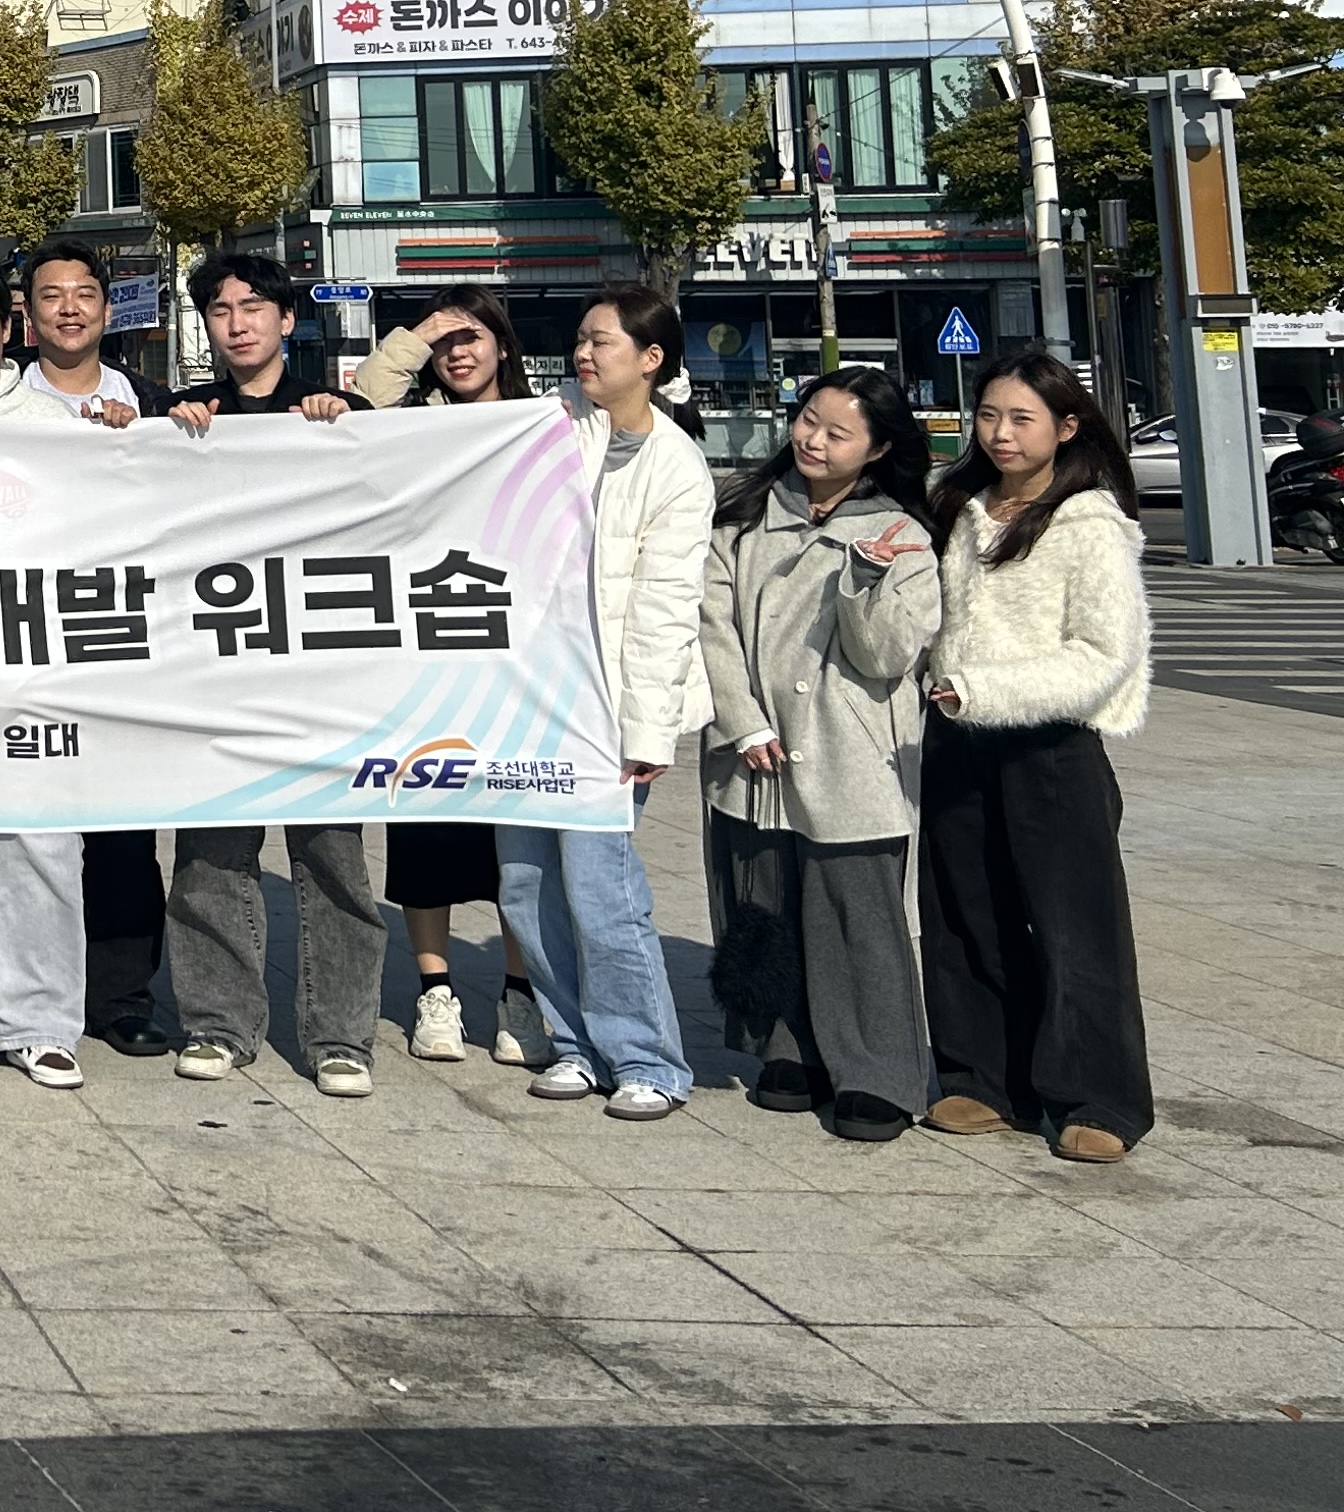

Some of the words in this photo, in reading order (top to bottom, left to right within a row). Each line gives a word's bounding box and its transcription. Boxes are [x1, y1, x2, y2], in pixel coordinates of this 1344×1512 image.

[341, 8, 374, 24] 수제
[353, 42, 394, 55] 돈까스
[396, 43, 407, 53] &
[409, 41, 436, 53] 피자
[438, 40, 449, 52] &
[451, 39, 493, 51] 파스타
[192, 548, 512, 657] 워크숍
[3, 722, 80, 759] 일대
[352, 746, 478, 794] RISE
[486, 760, 576, 778] 조선대학교
[486, 778, 576, 795] RISE사업단
